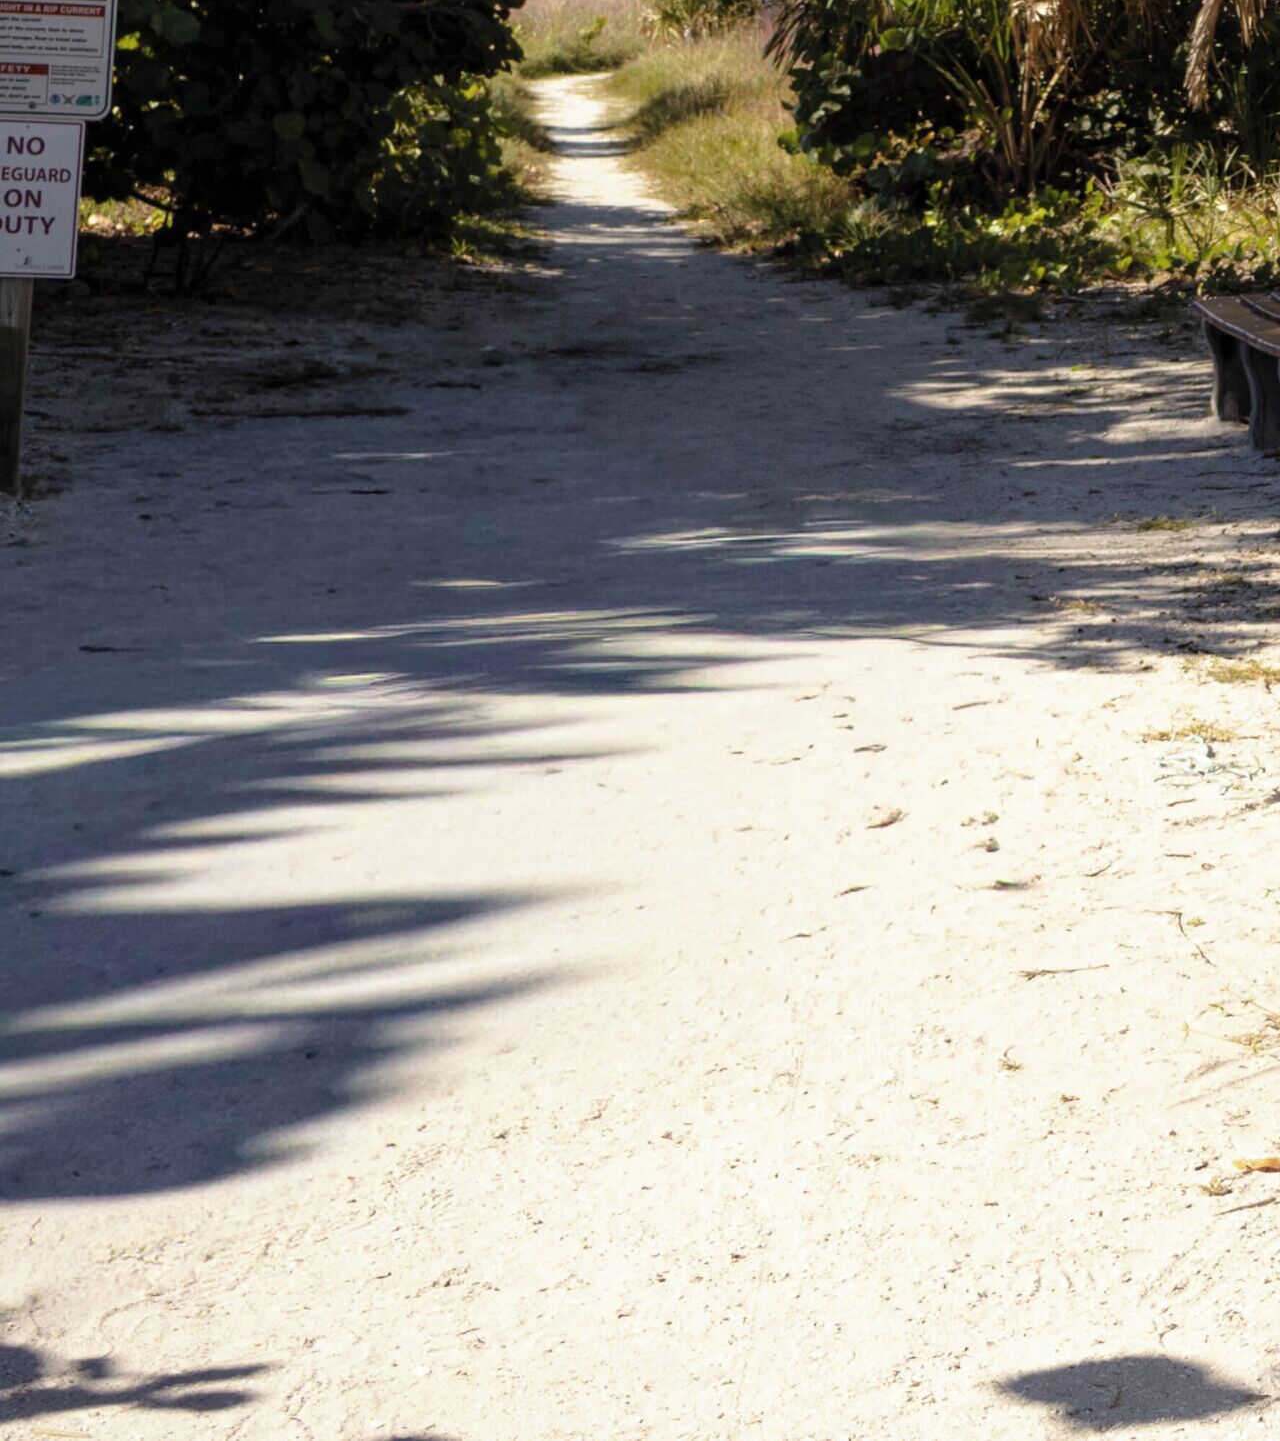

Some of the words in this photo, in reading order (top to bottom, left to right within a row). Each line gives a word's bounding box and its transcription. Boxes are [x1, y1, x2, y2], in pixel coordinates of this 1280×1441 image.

[60, 7, 102, 15] CURRENT
[0, 65, 30, 73] FETY
[7, 135, 46, 155] NO
[2, 167, 71, 183] EGUARD
[4, 188, 42, 208] ON
[0, 216, 56, 235] UTY
